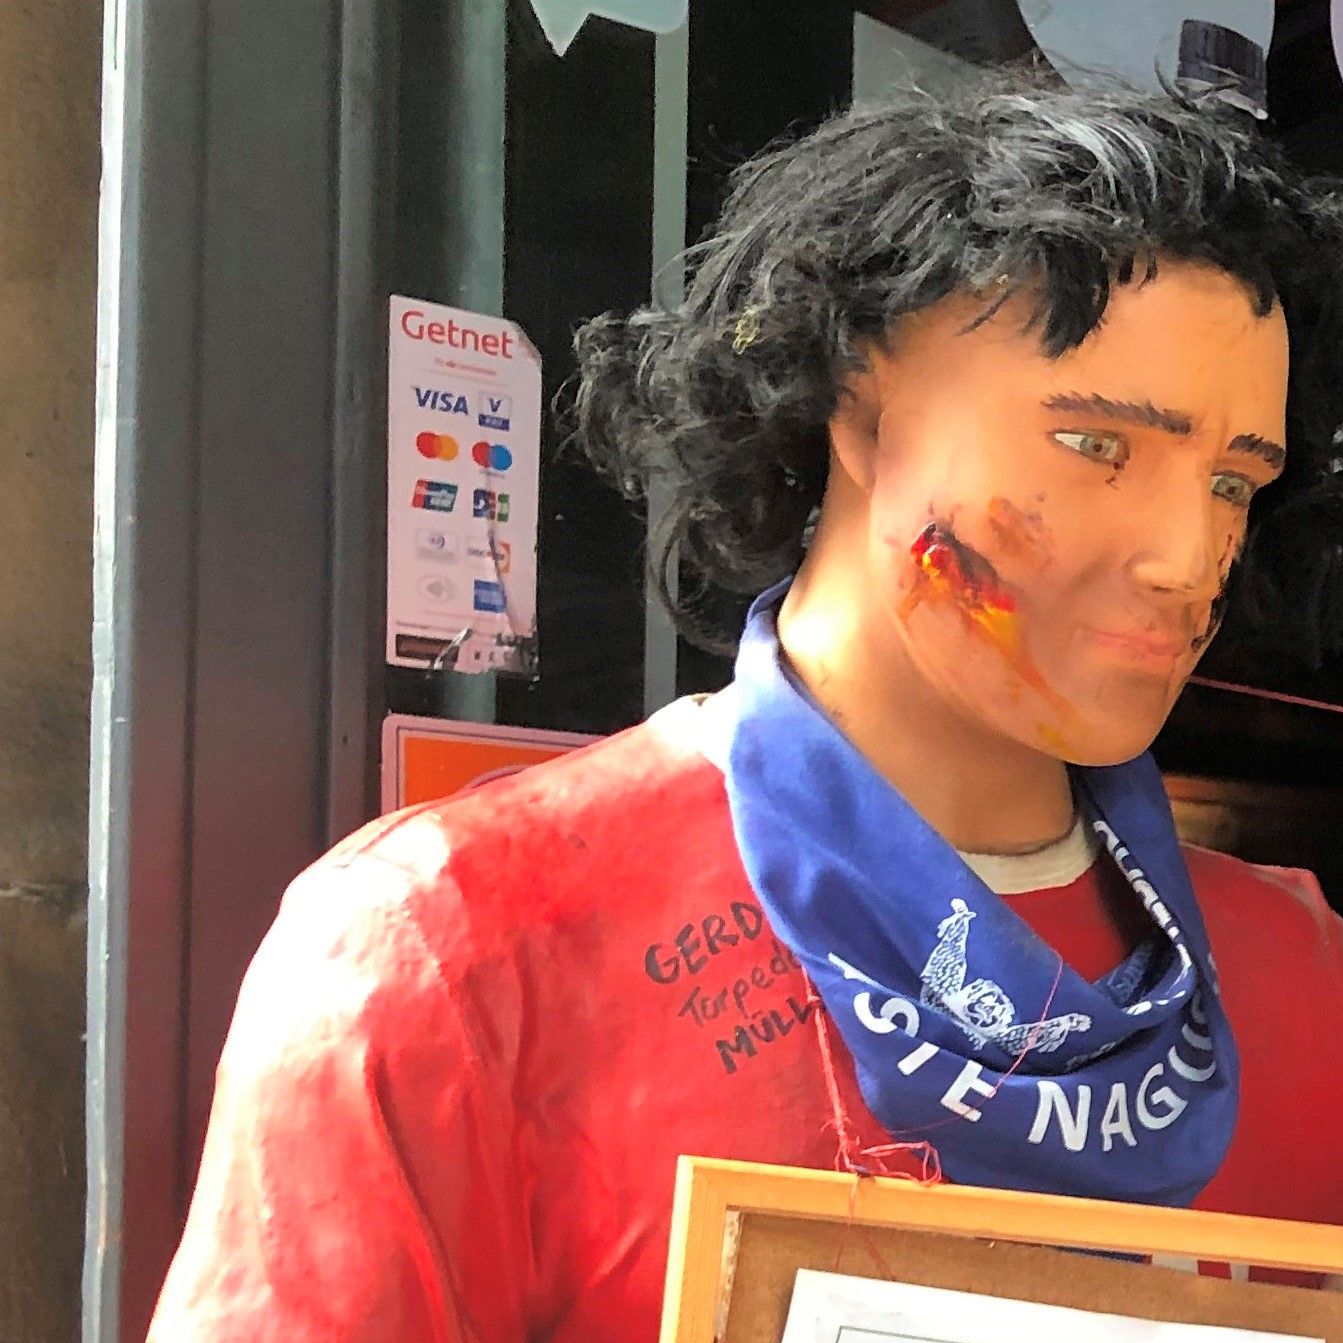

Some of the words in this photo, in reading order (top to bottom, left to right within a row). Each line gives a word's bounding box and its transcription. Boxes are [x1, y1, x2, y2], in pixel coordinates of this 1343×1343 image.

[401, 310, 514, 359] Getnet
[415, 387, 469, 415] VISA
[645, 901, 765, 984] GERD
